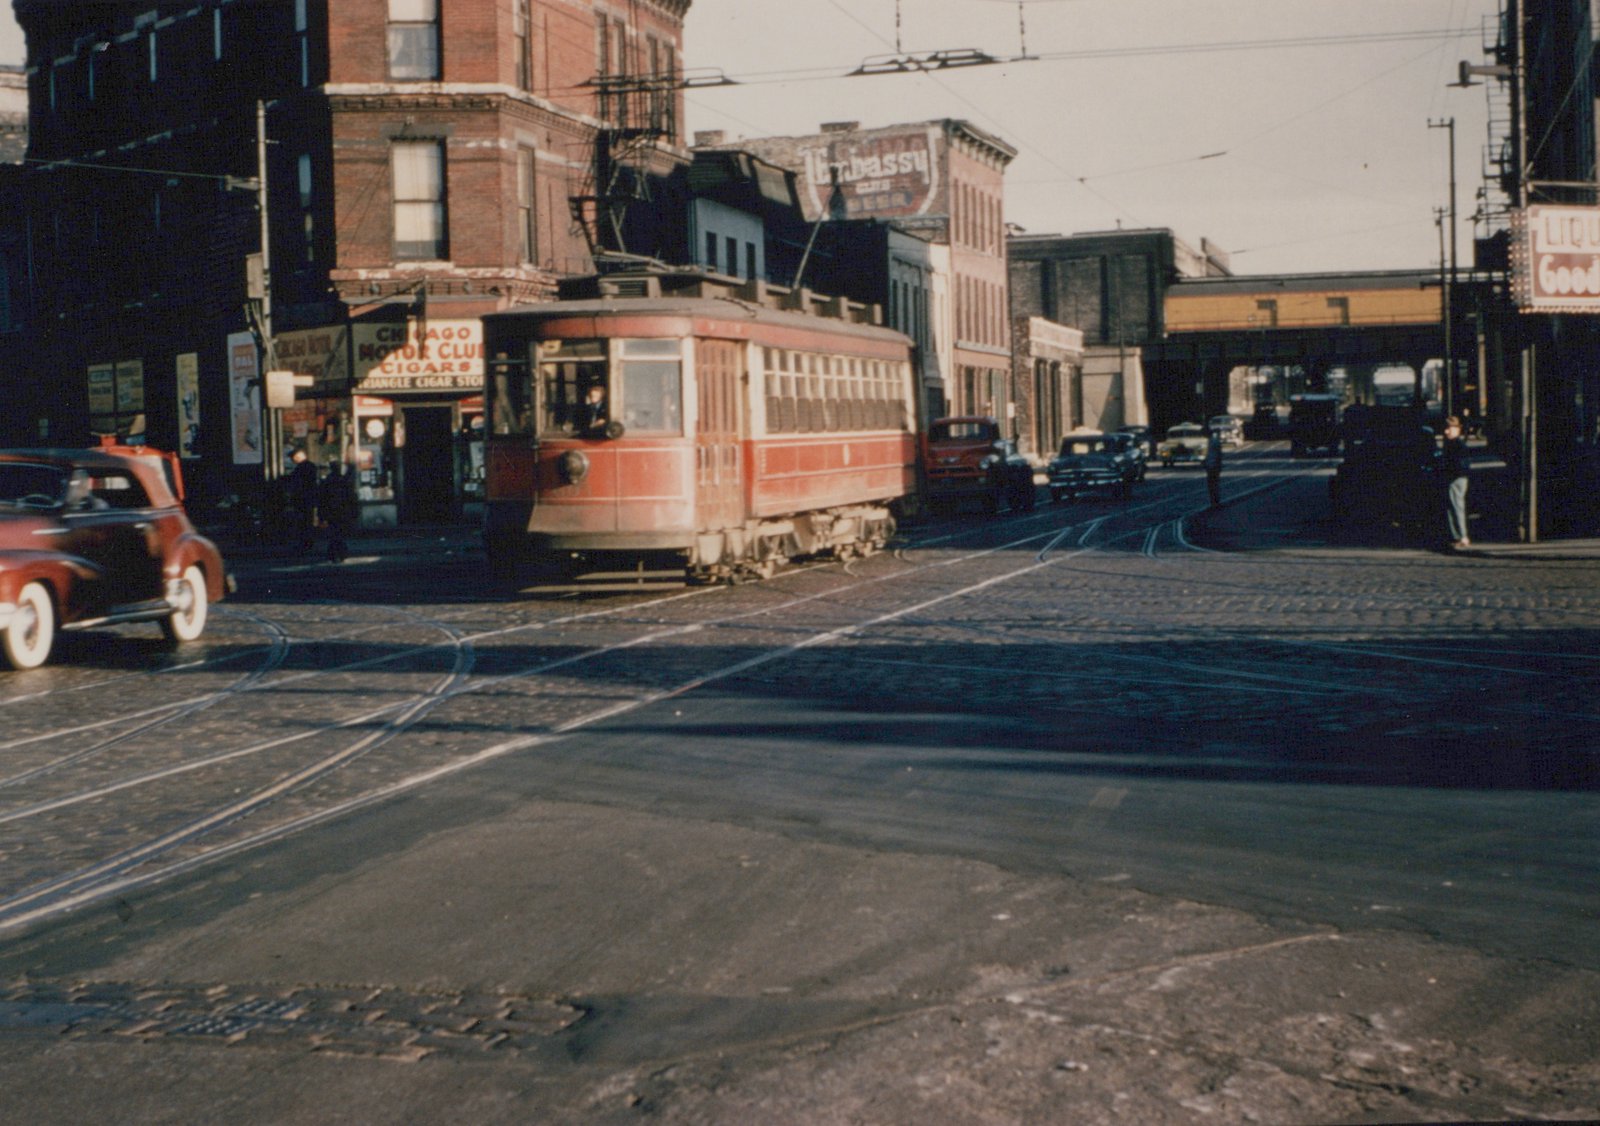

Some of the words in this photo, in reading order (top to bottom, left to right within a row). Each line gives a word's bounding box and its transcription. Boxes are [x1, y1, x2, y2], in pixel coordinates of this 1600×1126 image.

[358, 344, 430, 362] MOTOR
[380, 362, 471, 375] CIGARS
[415, 376, 452, 388] CIGAR
